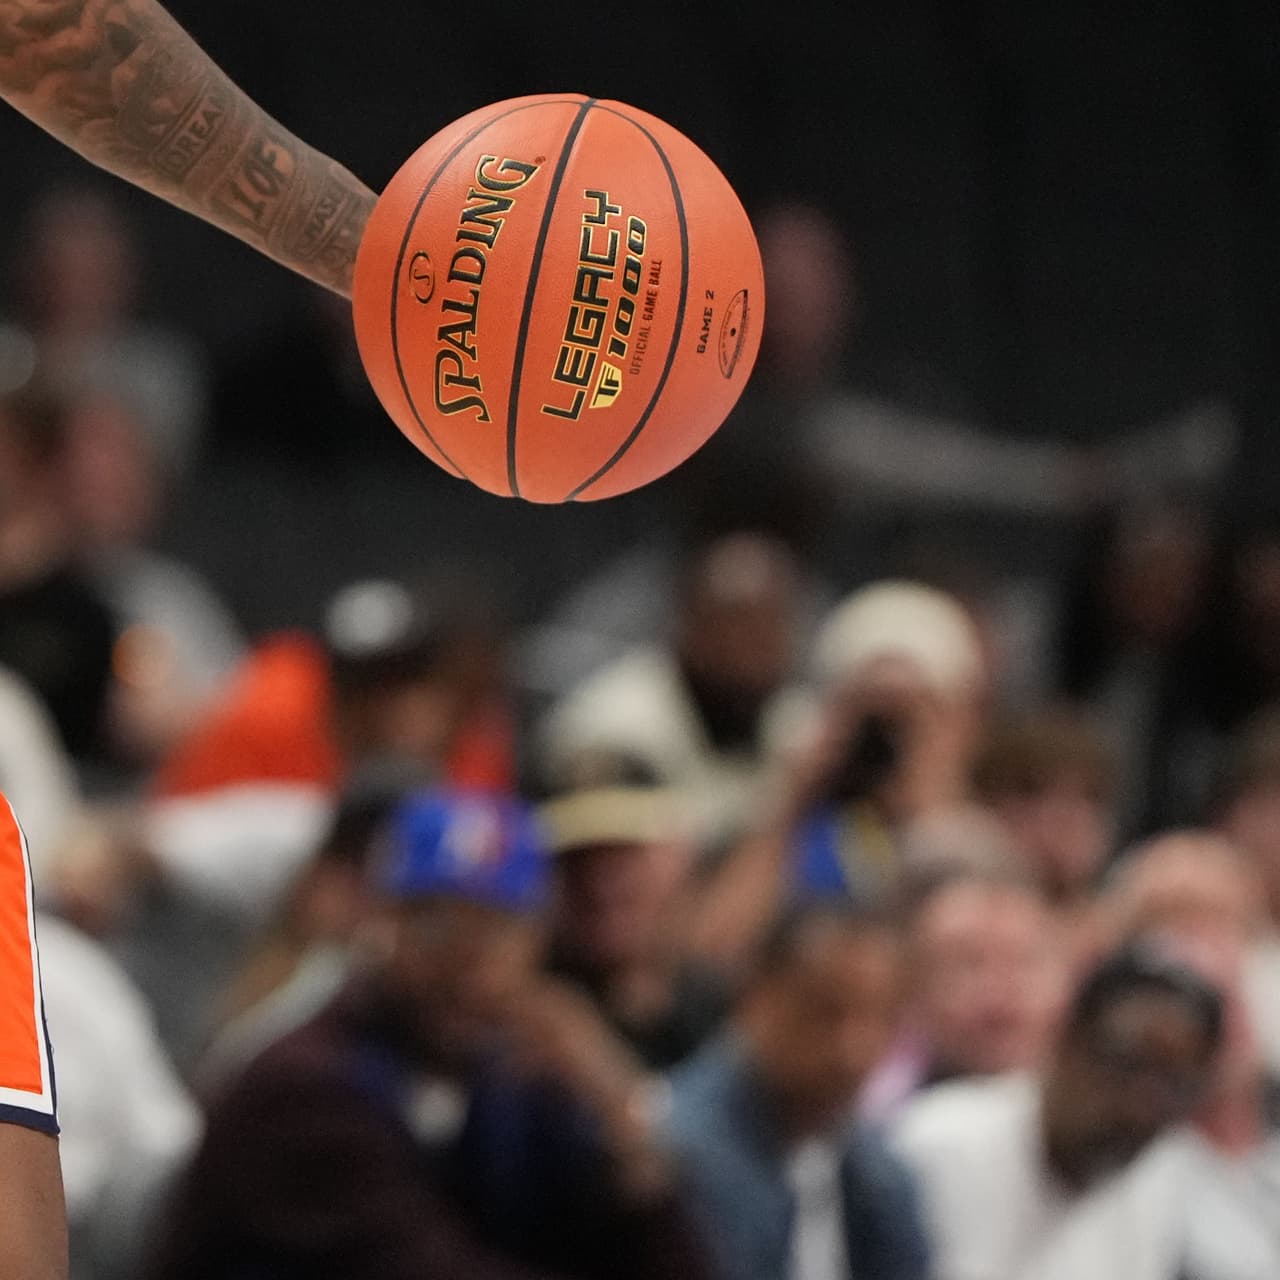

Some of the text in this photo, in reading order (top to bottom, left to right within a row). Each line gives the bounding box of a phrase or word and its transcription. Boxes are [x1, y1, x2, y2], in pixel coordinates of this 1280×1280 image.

[434, 154, 542, 424] SPALDING
[540, 188, 622, 422] LEGACY
[590, 215, 647, 408] TF 1000
[629, 259, 662, 376] OFFICIAL GAME BALL
[696, 289, 714, 354] GAME 2
